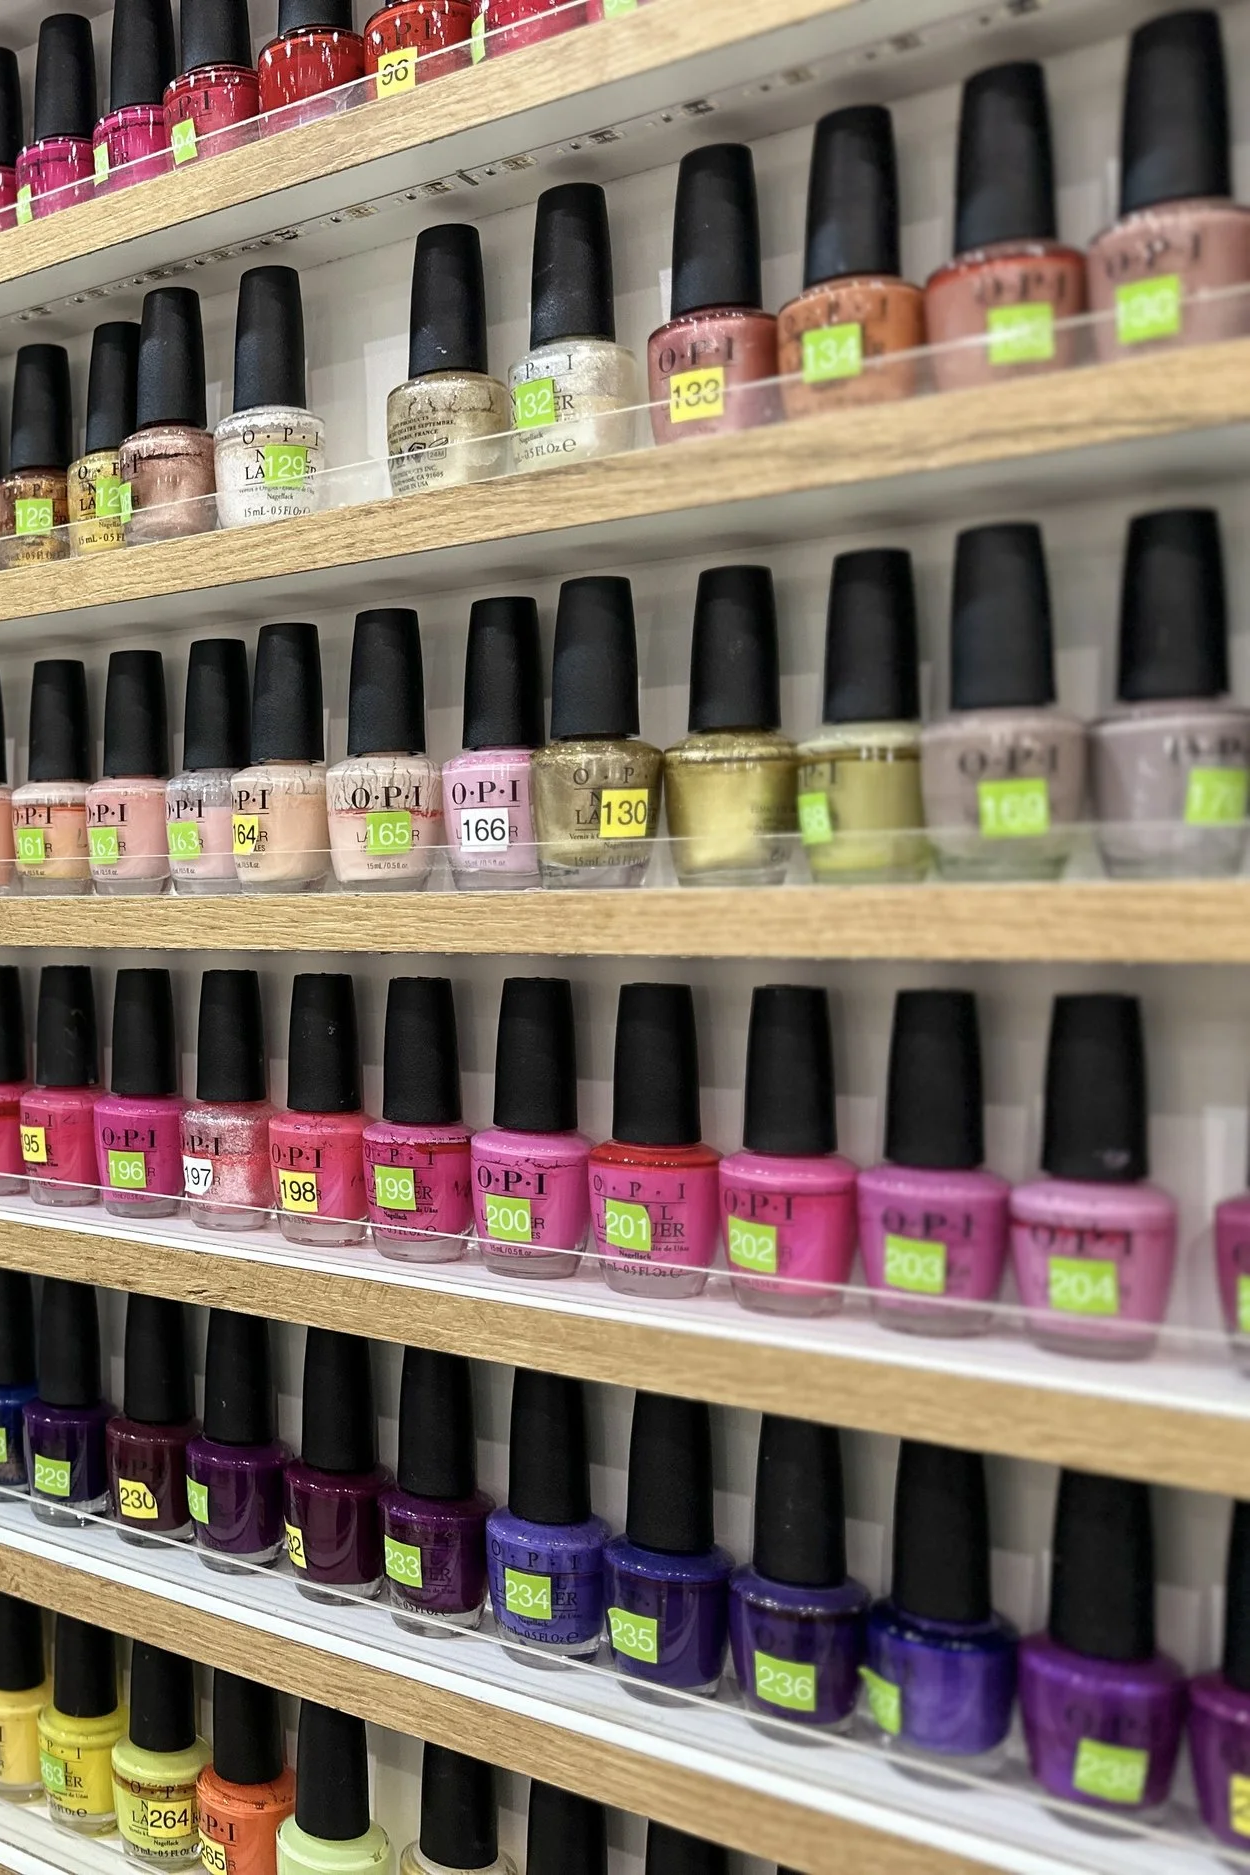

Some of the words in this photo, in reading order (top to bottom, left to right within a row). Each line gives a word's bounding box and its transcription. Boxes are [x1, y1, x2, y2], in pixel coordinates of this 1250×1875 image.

[805, 336, 857, 375] 134
[516, 389, 552, 420] 132
[673, 379, 720, 410] 133
[265, 455, 305, 478] 129
[97, 486, 120, 508] 12
[16, 507, 51, 528] 126
[602, 800, 647, 826] 130
[171, 831, 198, 852] 163
[367, 822, 410, 846] 165
[462, 818, 506, 842] 166
[18, 837, 43, 855] 161
[91, 836, 117, 857] 162
[109, 1160, 144, 1181] 196
[184, 1166, 211, 1187] 197
[477, 1165, 547, 1195] O·P·I
[280, 1179, 316, 1202] 198
[376, 1176, 413, 1201] 199
[487, 1205, 530, 1233] 200
[607, 1212, 647, 1241] 201
[730, 1229, 774, 1263] 202
[886, 1248, 944, 1288] 203
[1051, 1269, 1116, 1305] 204
[35, 1465, 69, 1489] 229
[120, 1487, 156, 1510] 230
[385, 1547, 420, 1578] 233
[506, 1580, 550, 1610] 234
[611, 1617, 654, 1653] 235
[758, 1666, 813, 1701] 236
[150, 1808, 190, 1830] 264
[200, 1838, 225, 1871] 265
